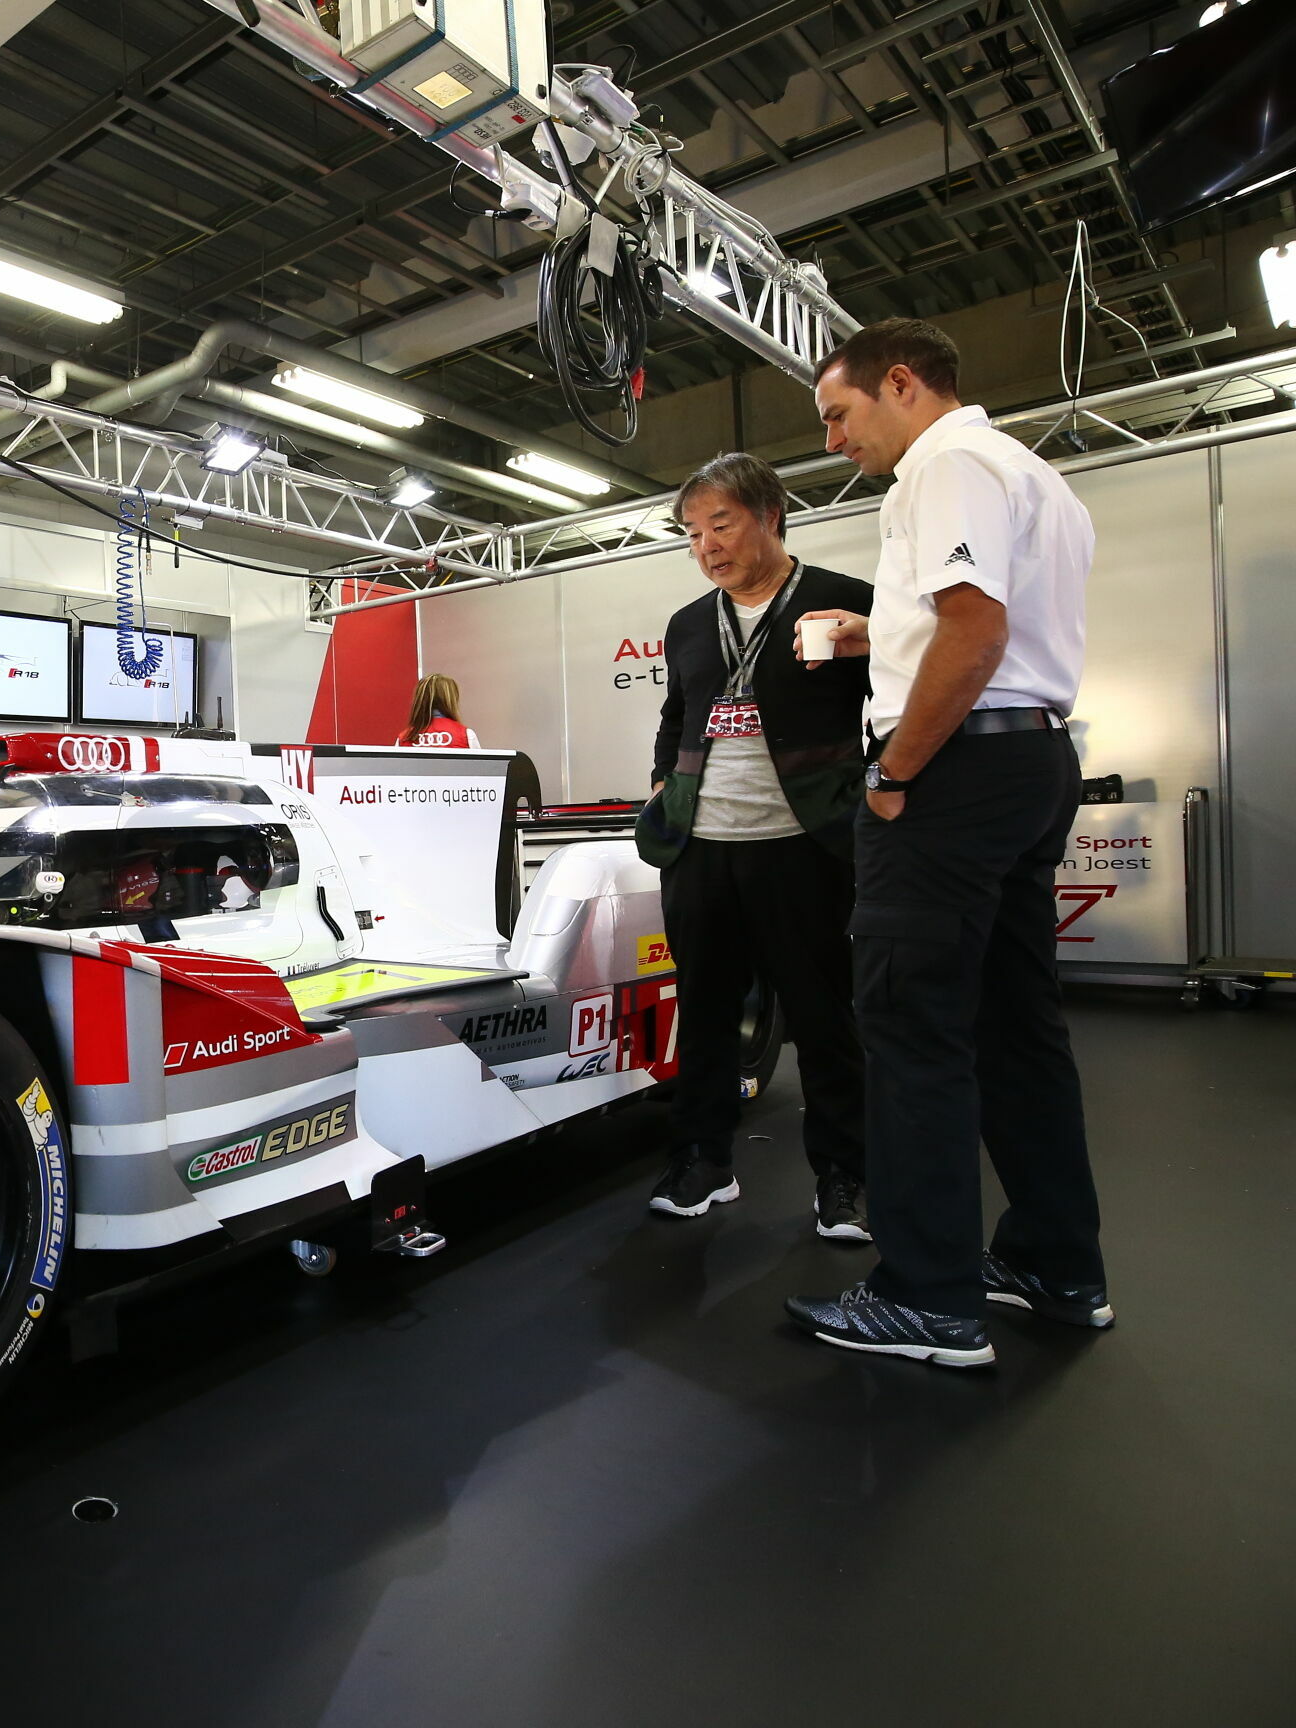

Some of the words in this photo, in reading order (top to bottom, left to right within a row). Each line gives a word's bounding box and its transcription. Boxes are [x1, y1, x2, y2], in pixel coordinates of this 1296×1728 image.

[281, 749, 314, 794] HY
[280, 804, 311, 820] ORIS
[339, 785, 382, 805] Audi
[387, 787, 438, 803] e-tron
[441, 790, 498, 807] quattro
[1075, 836, 1153, 852] Sport
[1085, 856, 1152, 872] Joest
[192, 1034, 238, 1060] Audi
[243, 1025, 292, 1052] Sport
[459, 1004, 548, 1044] AETHRA
[578, 1004, 606, 1046] P1
[556, 1052, 610, 1083] WEC
[204, 1140, 258, 1176] Castrol
[260, 1102, 349, 1162] EDGE
[44, 1144, 65, 1283] MICHELIN
[8, 1320, 33, 1365] MICHELIN
